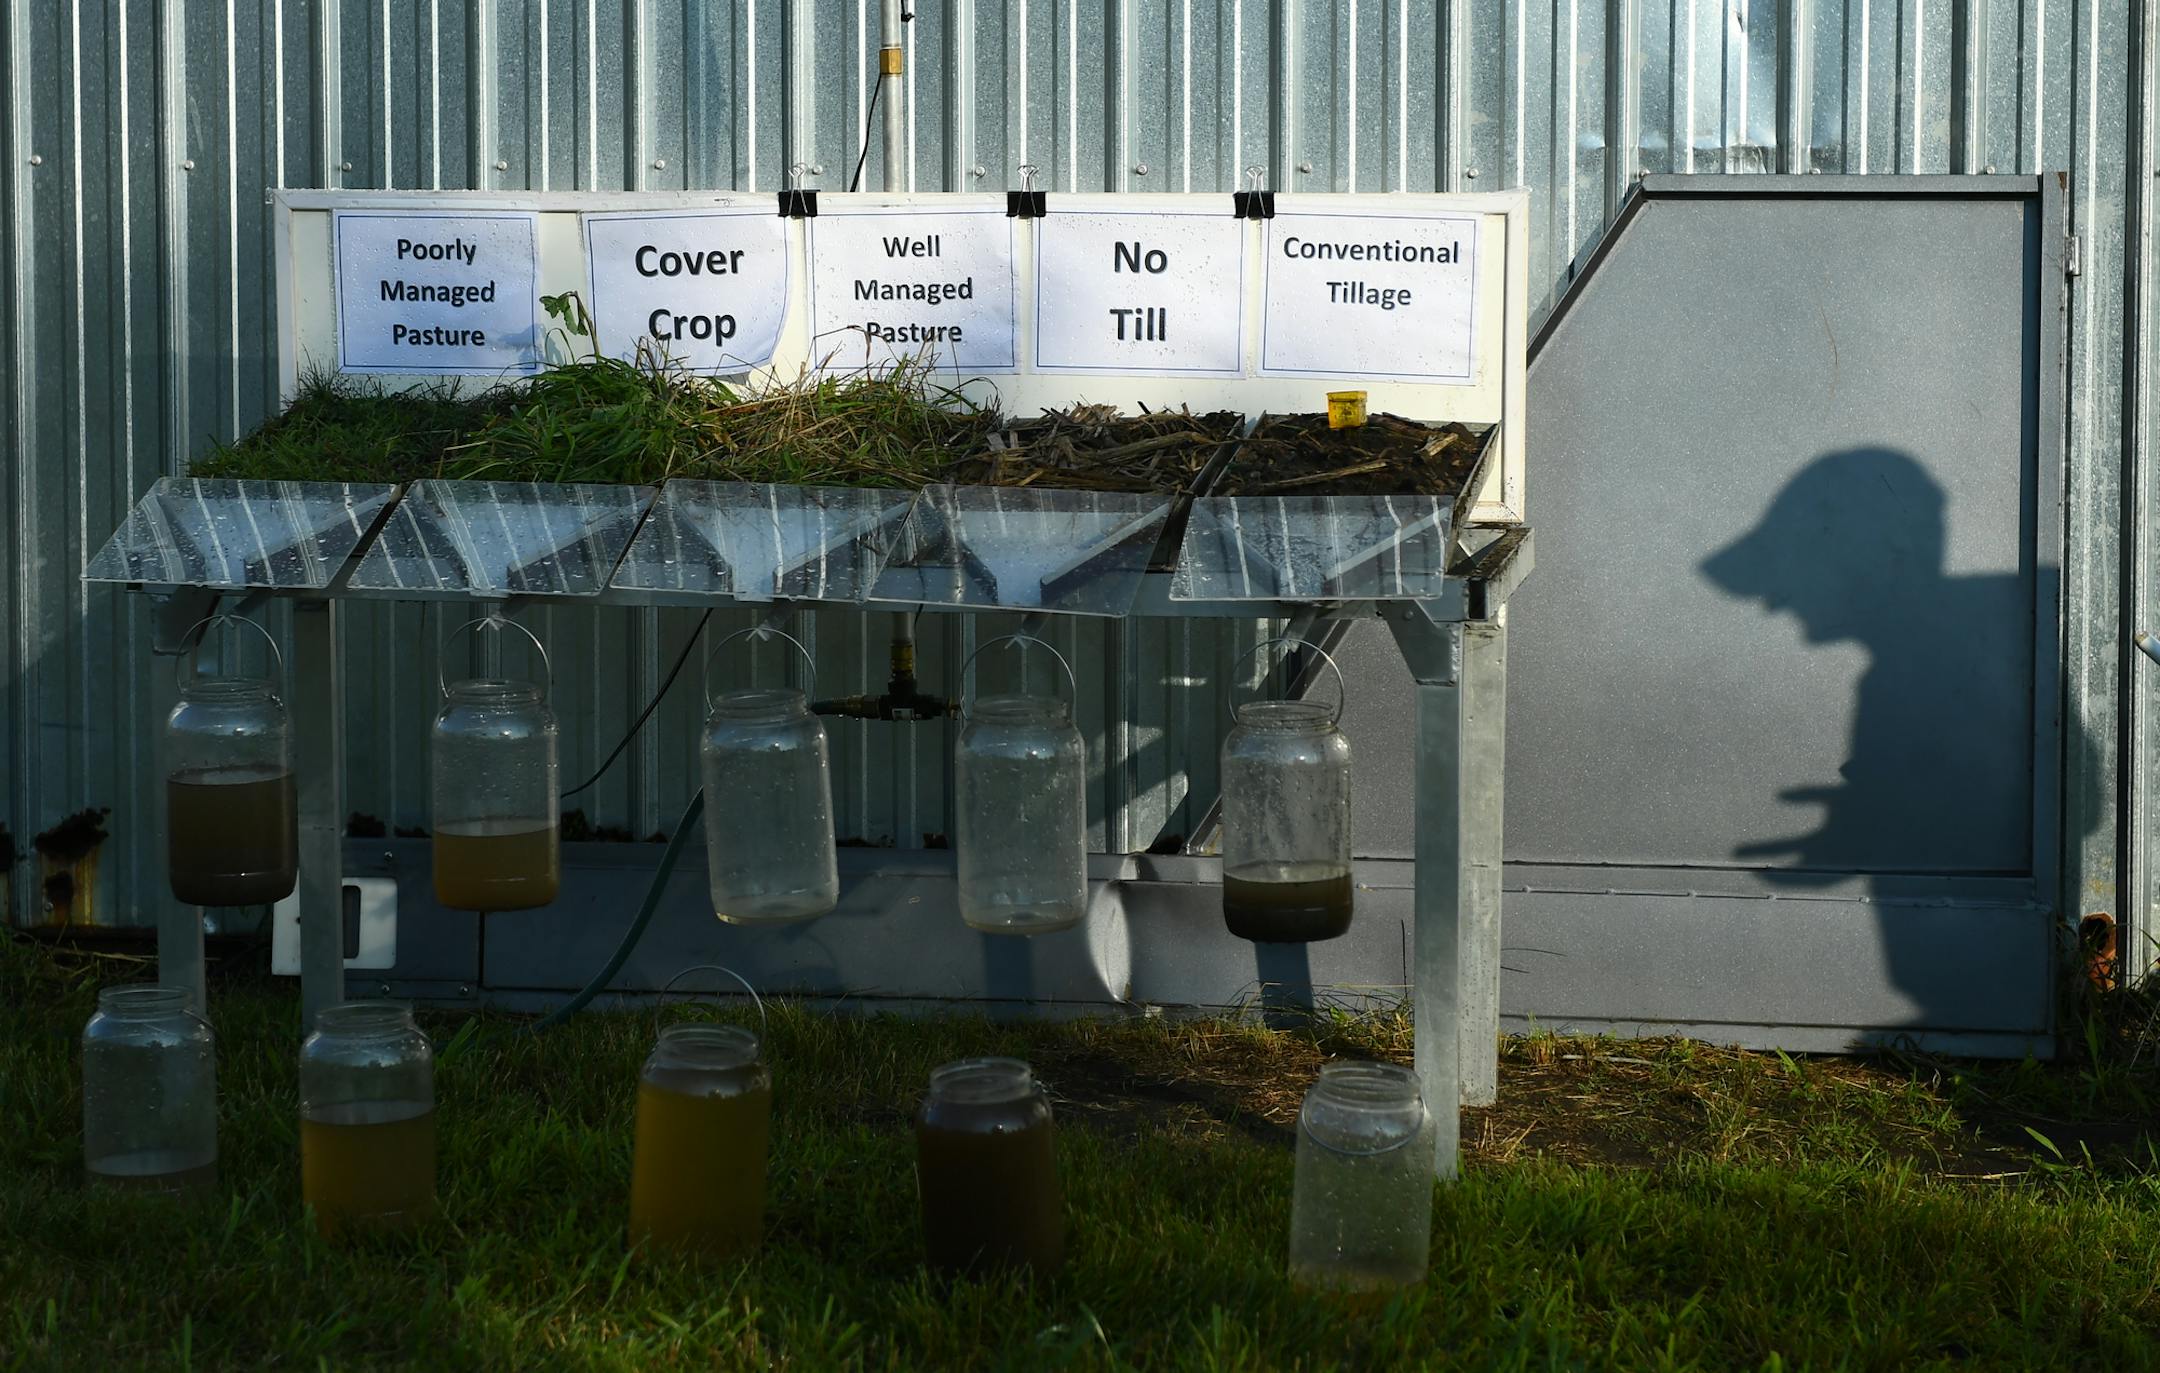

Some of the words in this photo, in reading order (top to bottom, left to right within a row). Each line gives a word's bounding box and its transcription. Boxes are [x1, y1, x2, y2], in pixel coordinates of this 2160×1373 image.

[398, 238, 476, 266] Poorly
[883, 235, 940, 258] Well
[1115, 242, 1167, 274] No
[1284, 237, 1458, 263] Conventional
[636, 246, 744, 277] Cover
[381, 280, 495, 308] Managed
[855, 277, 973, 305] Managed
[1327, 282, 1412, 310] Tillage
[393, 324, 486, 346] Pasture
[648, 309, 737, 346] Crop
[866, 322, 962, 343] Pasture
[1110, 308, 1166, 341] Till
